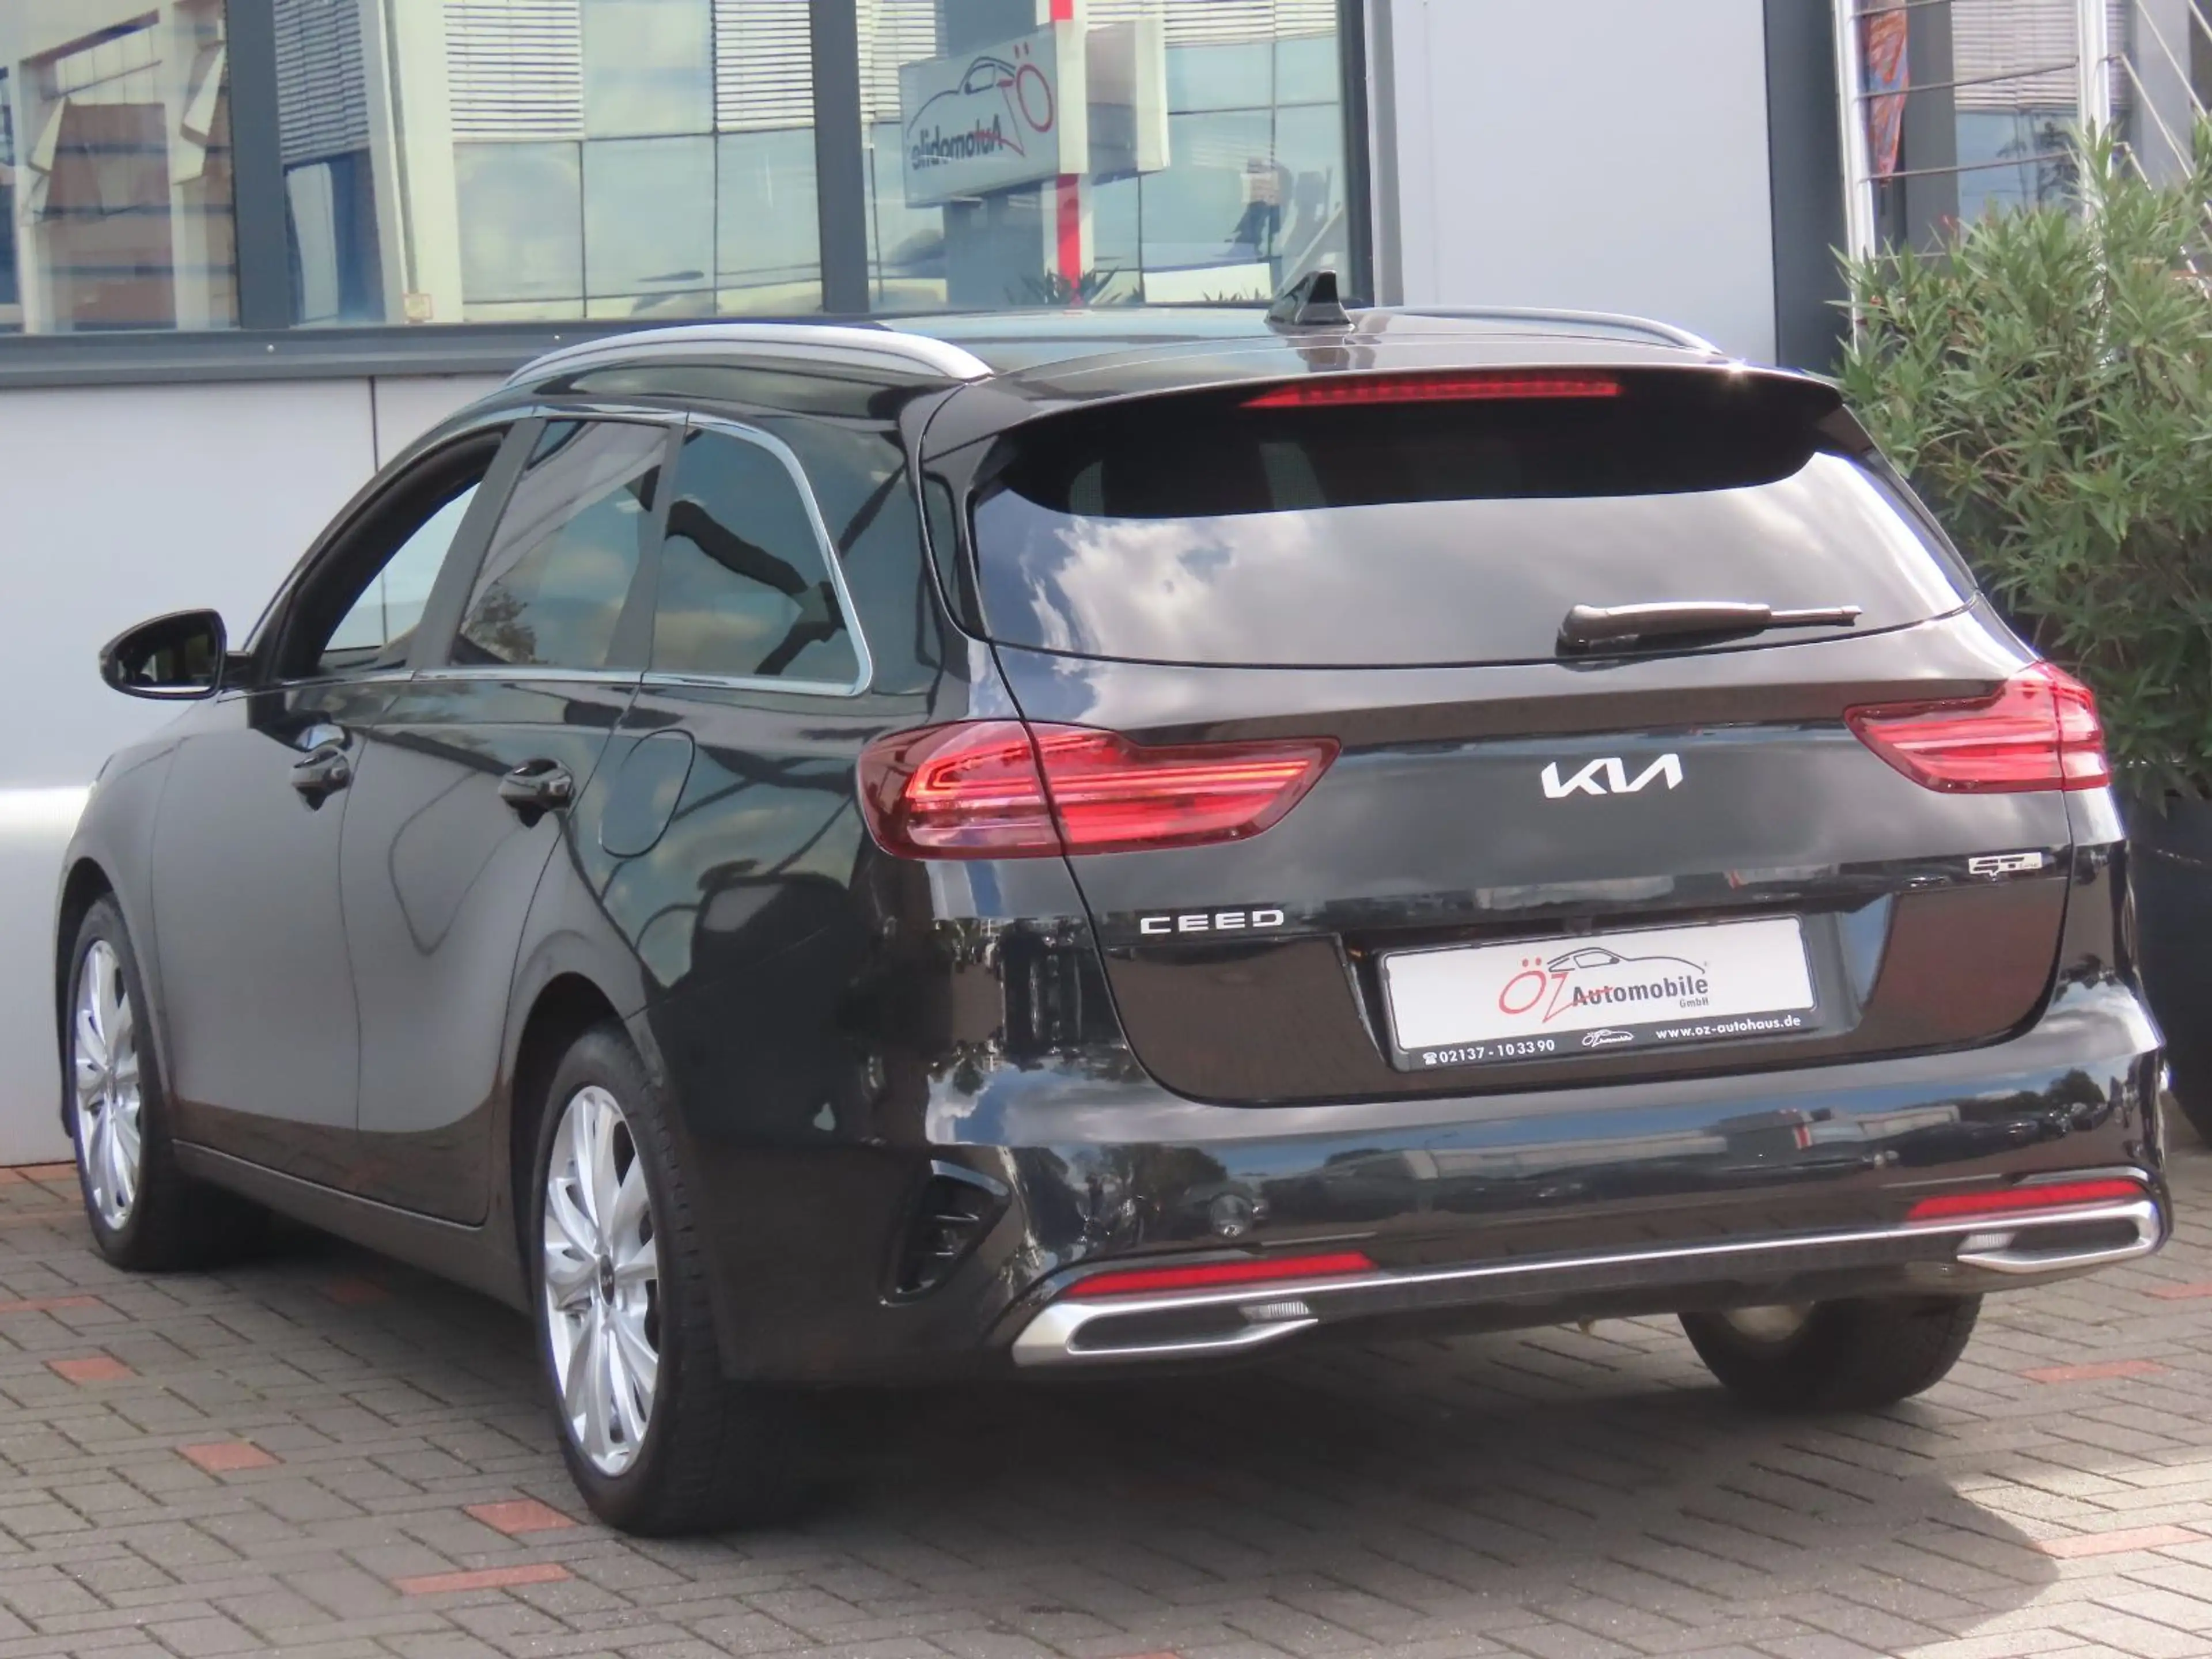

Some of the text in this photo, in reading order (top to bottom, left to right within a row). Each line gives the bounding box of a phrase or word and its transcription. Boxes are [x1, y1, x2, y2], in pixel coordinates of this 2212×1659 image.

[1541, 753, 1683, 798] KIA
[1141, 910, 1284, 934] CEED
[1499, 957, 1709, 1024] ÖZ Automobile
[1679, 997, 1709, 1008] GmbH
[1656, 1015, 1801, 1040] www.oz-autohaus.de
